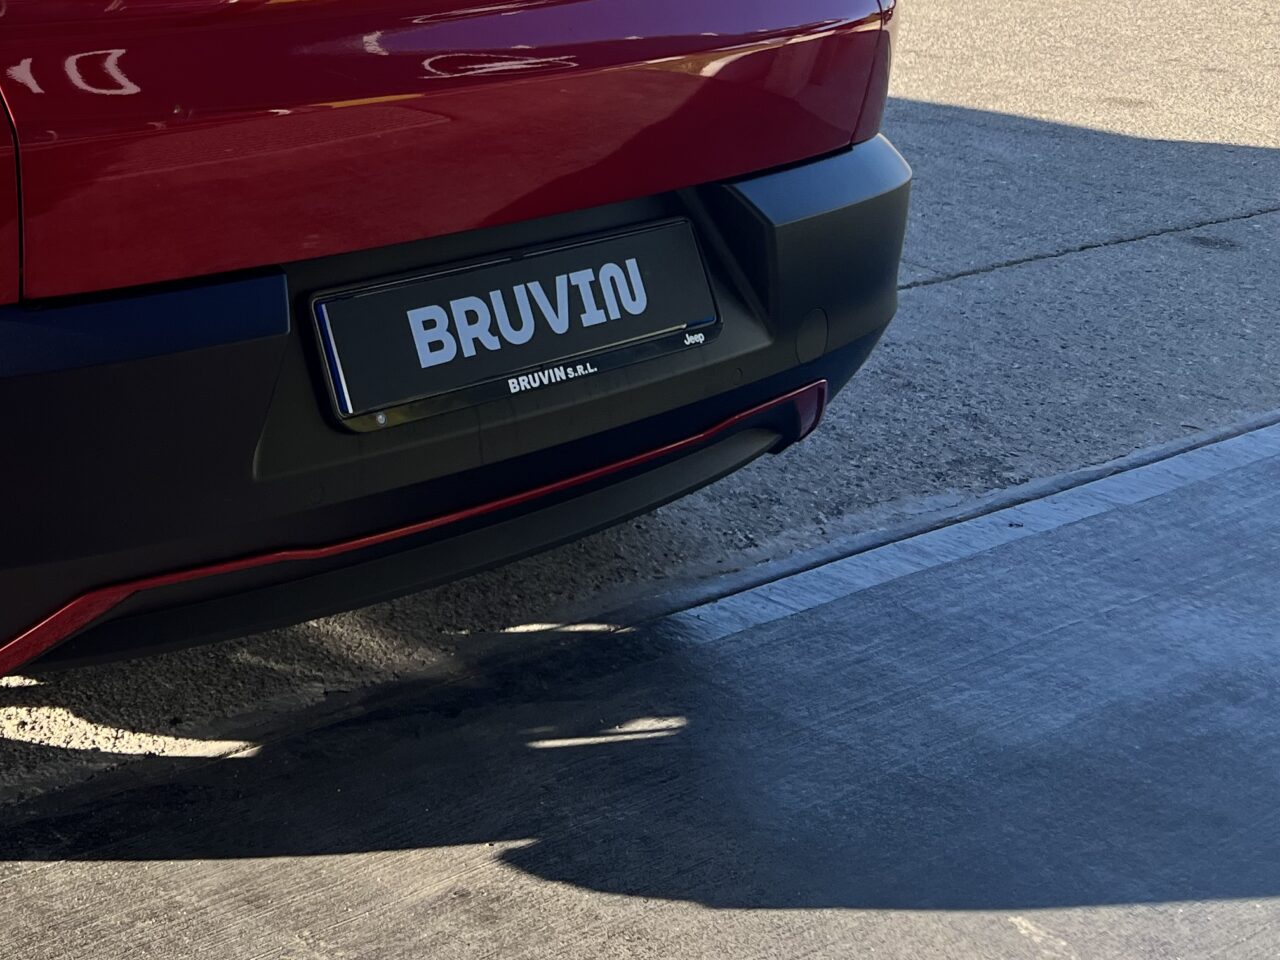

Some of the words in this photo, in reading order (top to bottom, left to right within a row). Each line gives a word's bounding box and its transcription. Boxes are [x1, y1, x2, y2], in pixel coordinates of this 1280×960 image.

[407, 257, 648, 369] BRUVIN
[683, 332, 705, 347] Jeep
[507, 365, 567, 394] BRUVIN
